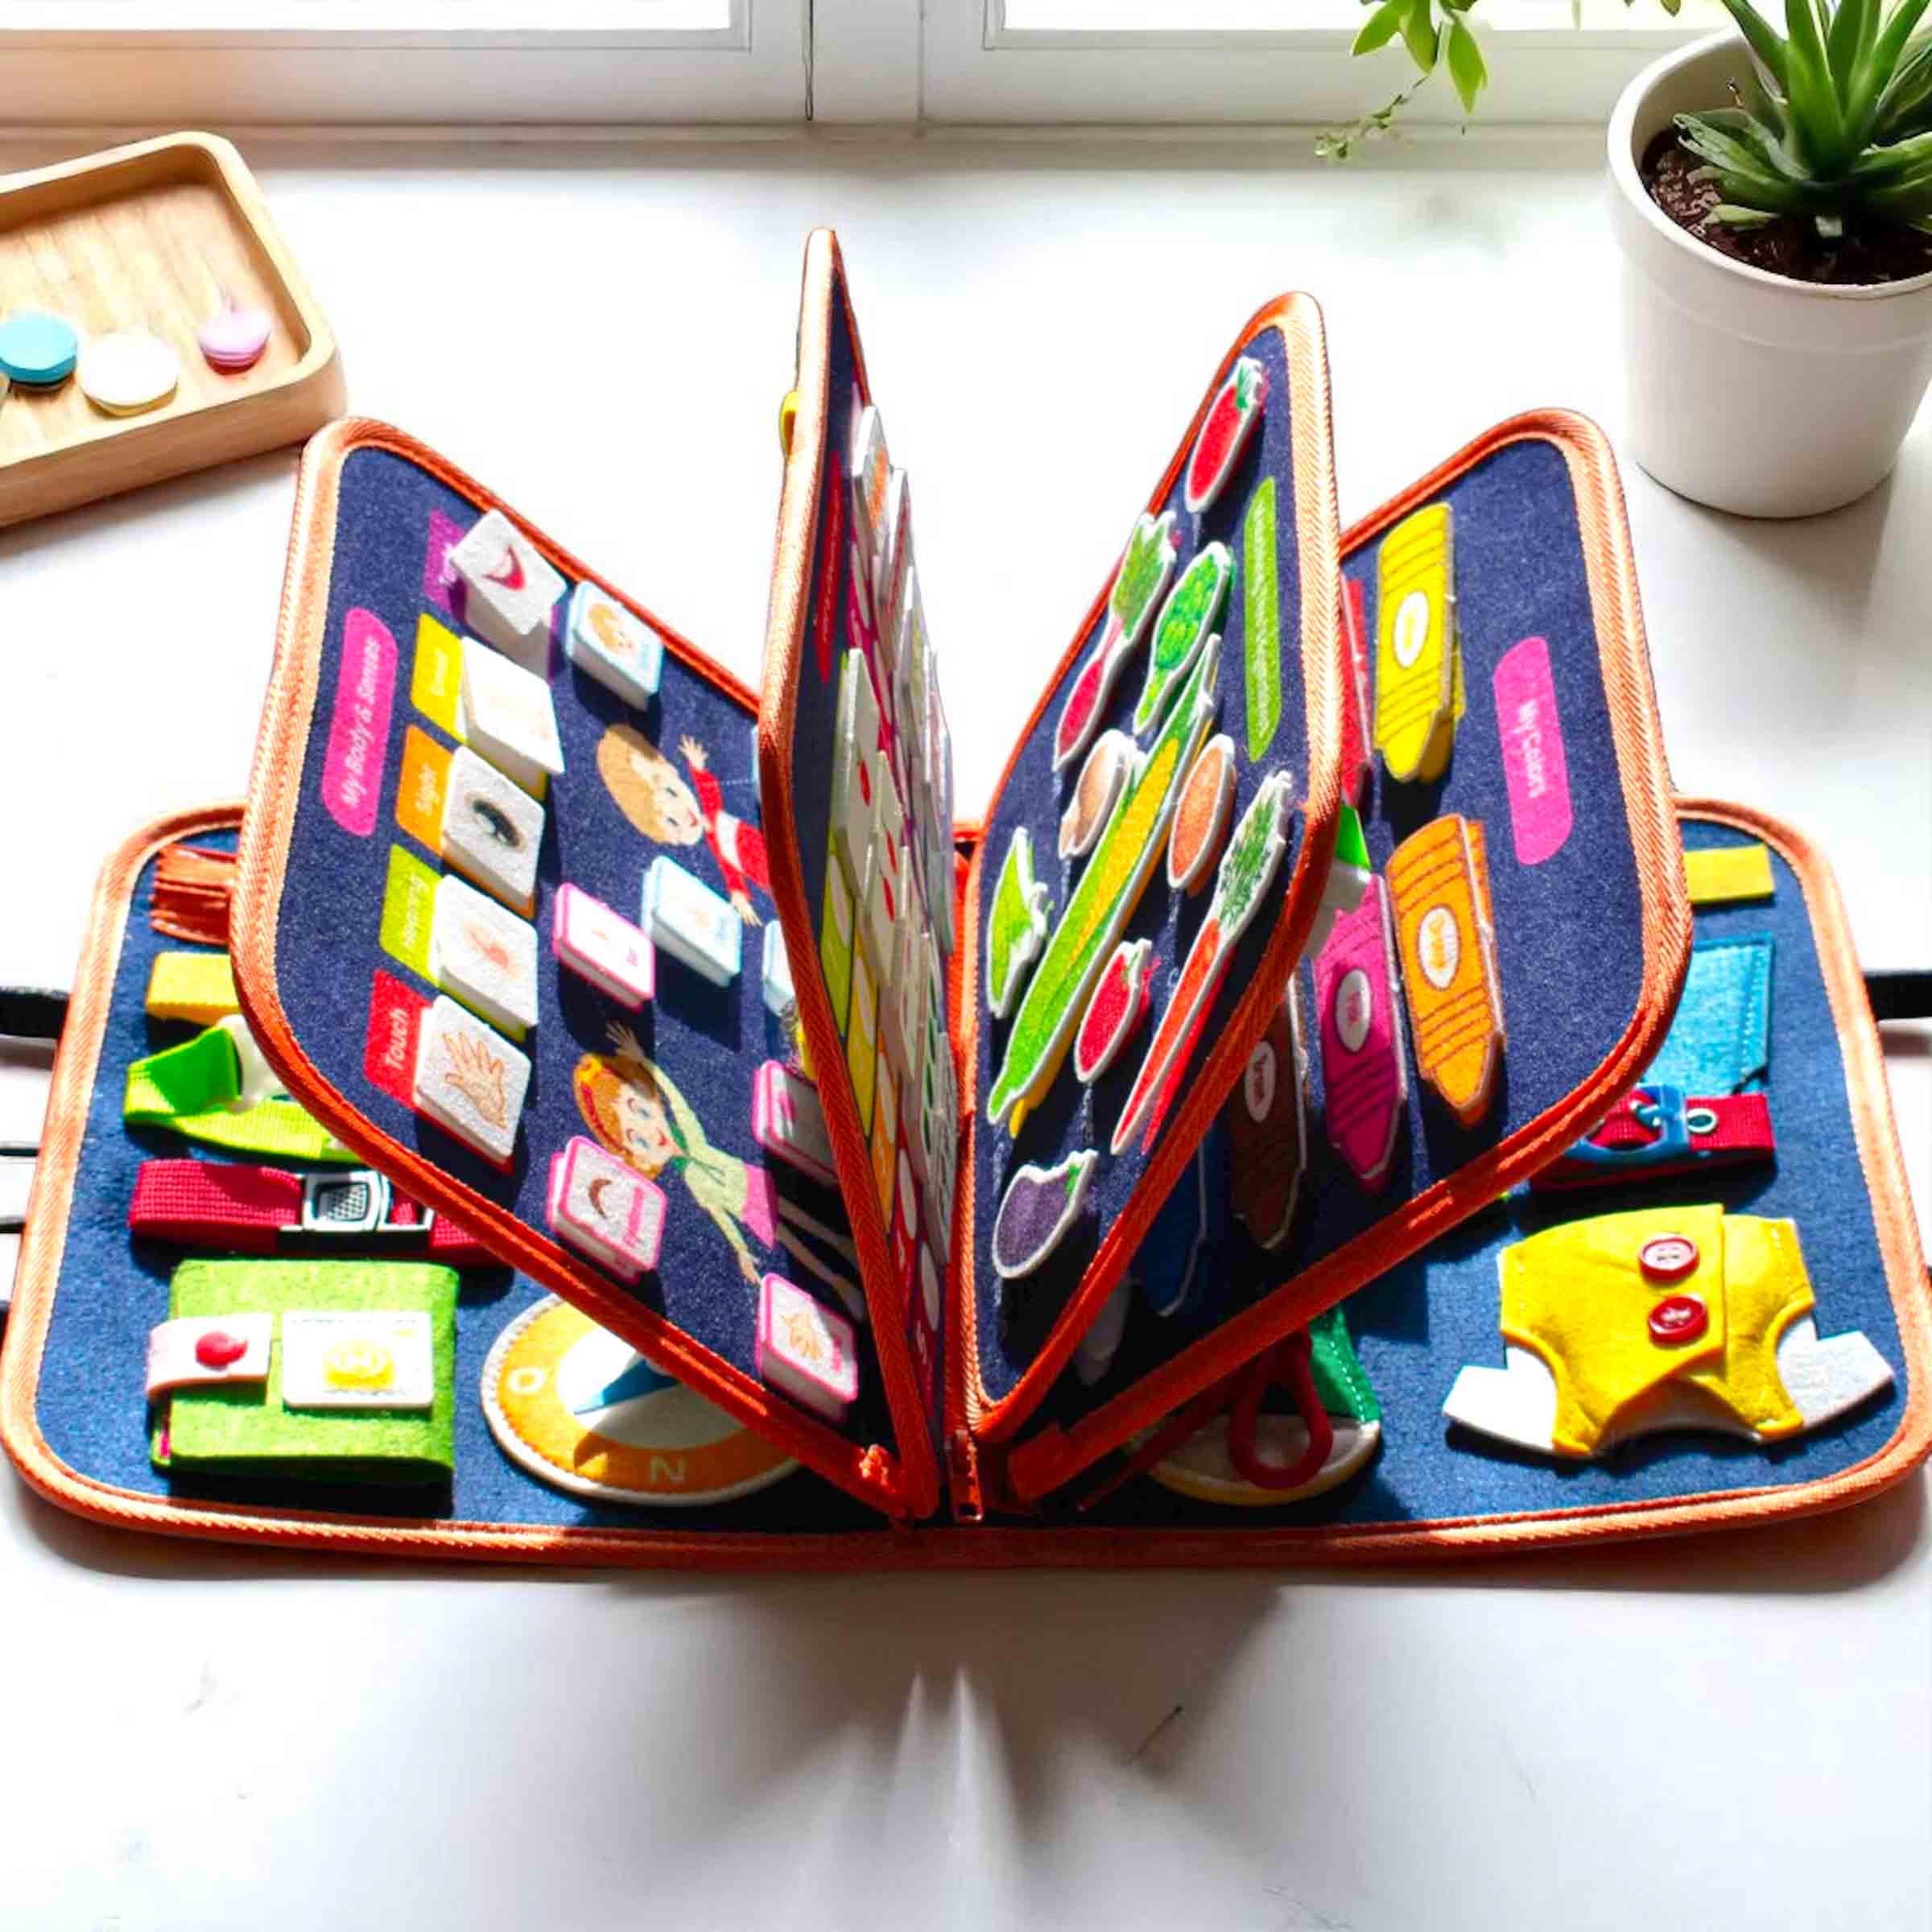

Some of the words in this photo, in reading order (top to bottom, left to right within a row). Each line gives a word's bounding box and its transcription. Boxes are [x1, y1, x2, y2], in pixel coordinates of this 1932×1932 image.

[354, 702, 373, 723] &
[345, 726, 375, 775] Body
[341, 774, 367, 808] My
[385, 1008, 409, 1069] Touch
[507, 1367, 544, 1395] O
[650, 1454, 687, 1484] N
